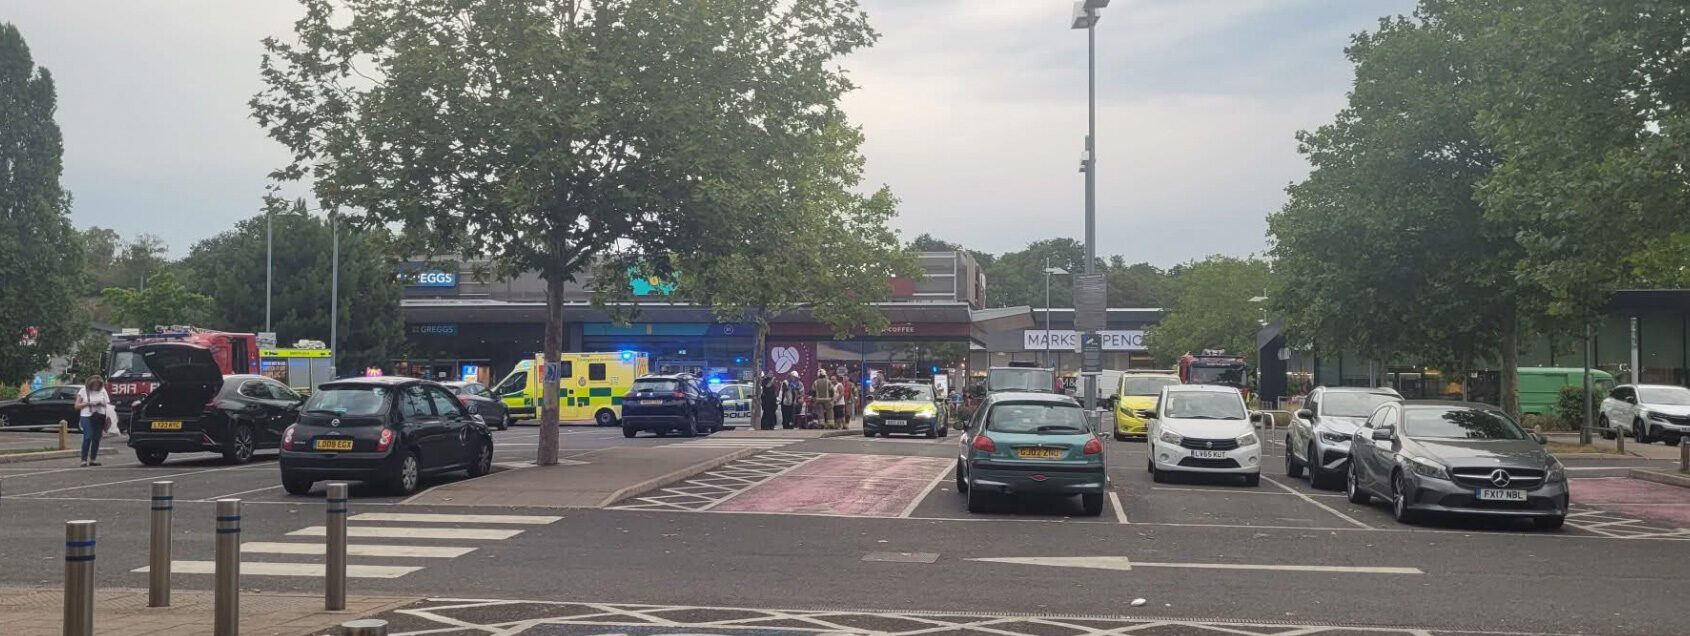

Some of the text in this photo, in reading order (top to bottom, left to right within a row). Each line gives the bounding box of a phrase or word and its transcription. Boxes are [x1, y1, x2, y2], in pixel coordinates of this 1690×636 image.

[413, 273, 453, 283] EGGS
[420, 325, 454, 333] GREGGS
[1028, 334, 1076, 347] MARKS
[1101, 334, 1142, 347] PENC
[1484, 490, 1523, 499] FX17 NBL
